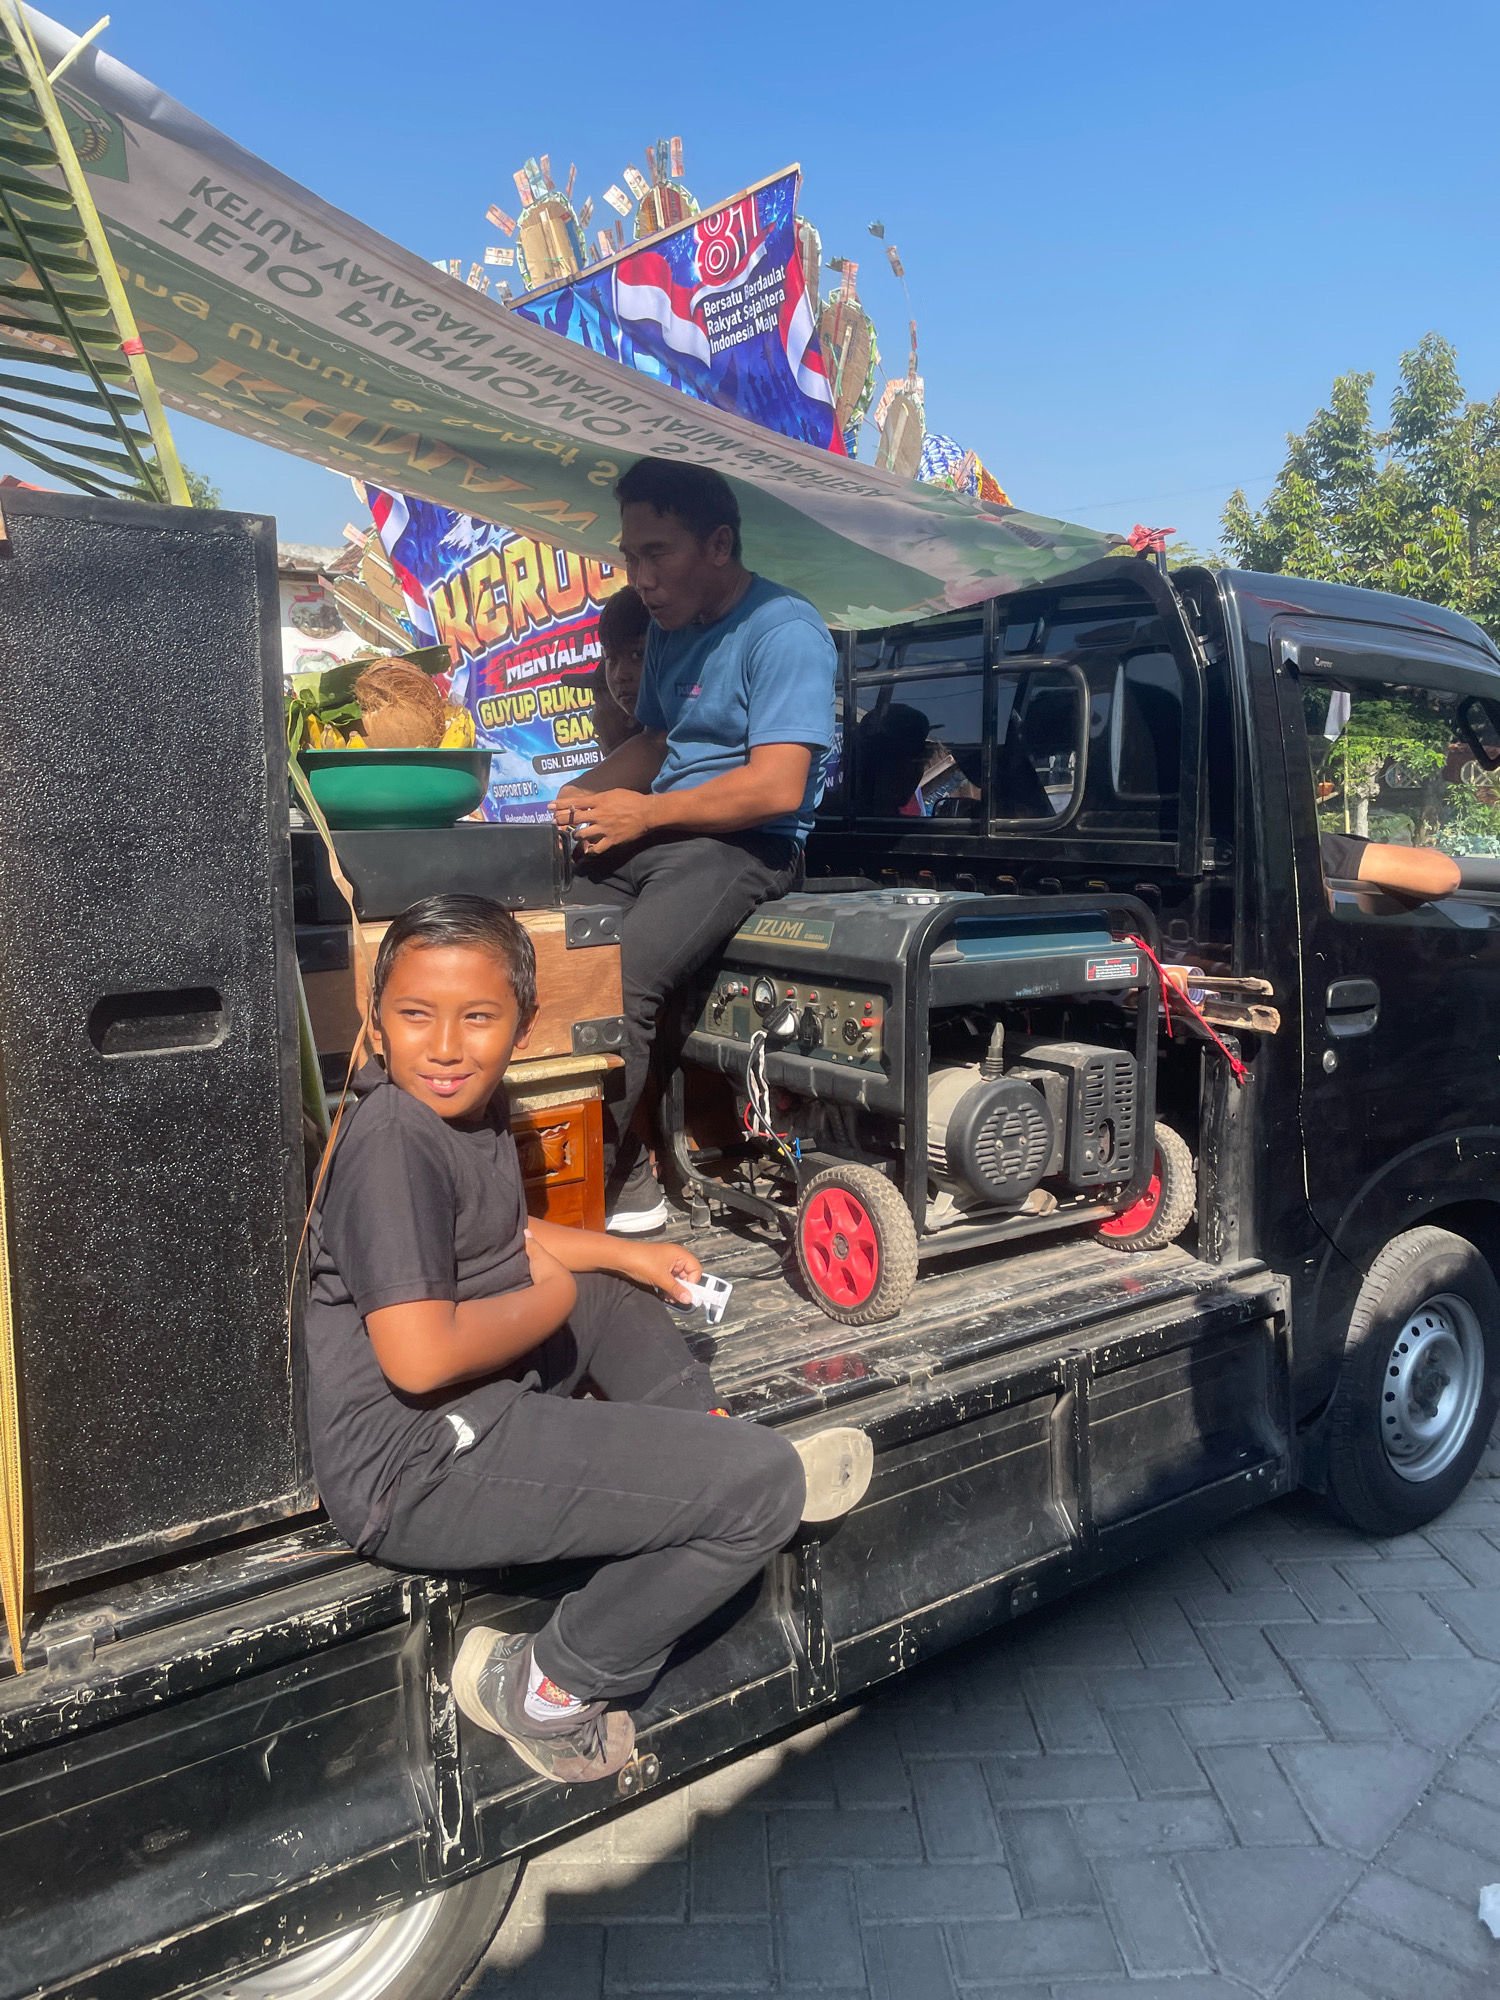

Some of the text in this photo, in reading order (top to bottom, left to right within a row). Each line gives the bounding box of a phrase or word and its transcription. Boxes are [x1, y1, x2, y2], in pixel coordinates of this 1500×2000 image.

[703, 264, 786, 317] Bersatu Berdaulat
[706, 288, 786, 336] Rakyat Sejahtera
[709, 312, 779, 354] Indonesia Maju
[480, 686, 596, 726] GUYUP RUKU
[541, 758, 562, 770] DSN.
[562, 753, 598, 769] LEMARIS
[493, 783, 522, 798] SUPPORT
[522, 781, 534, 796] BY
[752, 918, 805, 939] IZUMI
